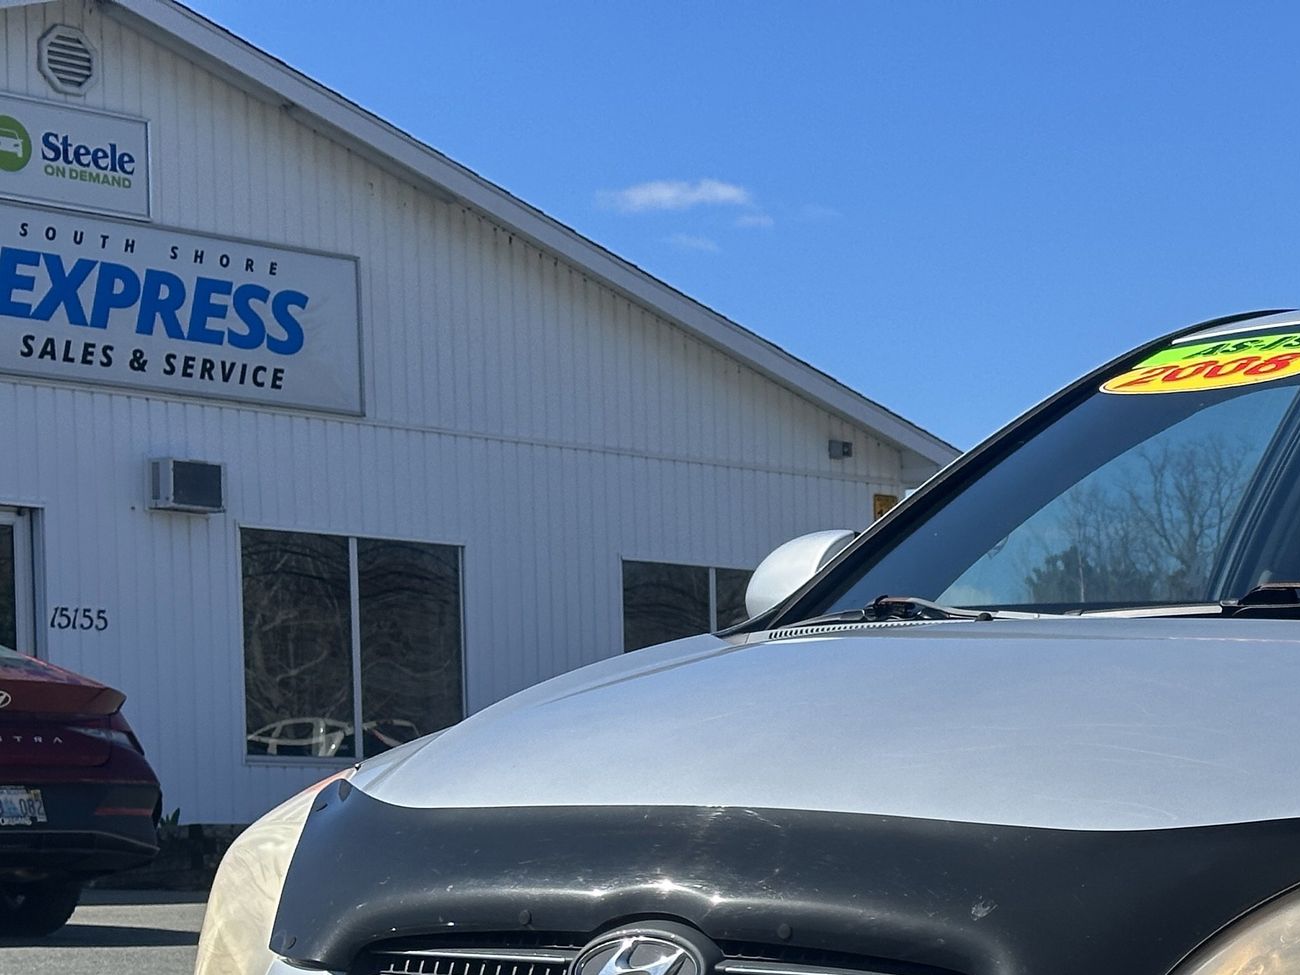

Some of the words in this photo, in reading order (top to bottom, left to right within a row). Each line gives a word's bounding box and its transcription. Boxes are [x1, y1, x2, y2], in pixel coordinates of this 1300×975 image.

[41, 132, 135, 176] Steele
[44, 166, 66, 180] ON
[69, 169, 132, 189] DEMAND
[19, 222, 135, 254] SOUTH
[170, 245, 278, 276] SHORE
[0, 246, 310, 356] EXPRESS
[20, 334, 114, 367] SALES
[129, 351, 147, 372] &
[163, 353, 285, 390] SERVICE
[50, 606, 108, 631] 15155
[0, 735, 63, 744] TRA
